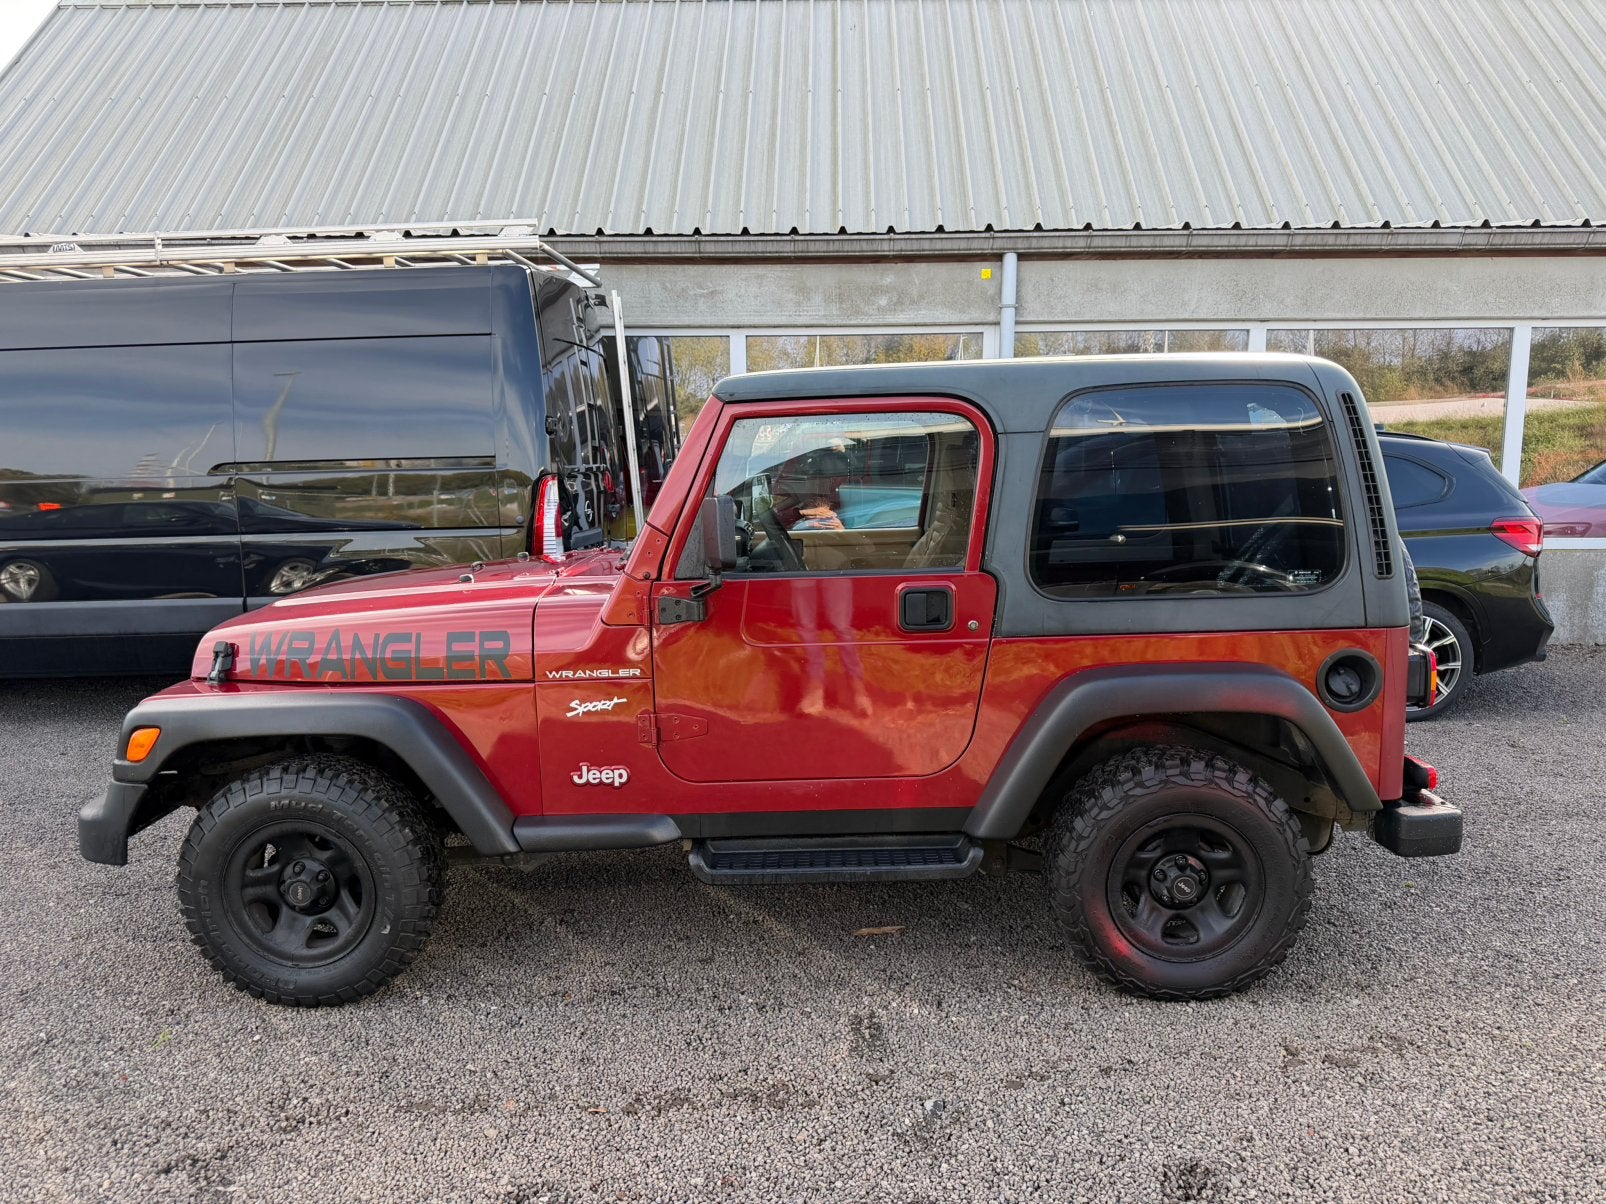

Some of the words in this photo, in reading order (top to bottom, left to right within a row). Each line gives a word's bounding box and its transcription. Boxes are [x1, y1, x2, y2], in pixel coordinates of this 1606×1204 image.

[249, 628, 512, 680] WRANGLER
[545, 668, 641, 678] WRANGLER
[565, 696, 628, 717] Sport
[572, 764, 629, 787] Jeep
[1176, 880, 1192, 894] Jeep
